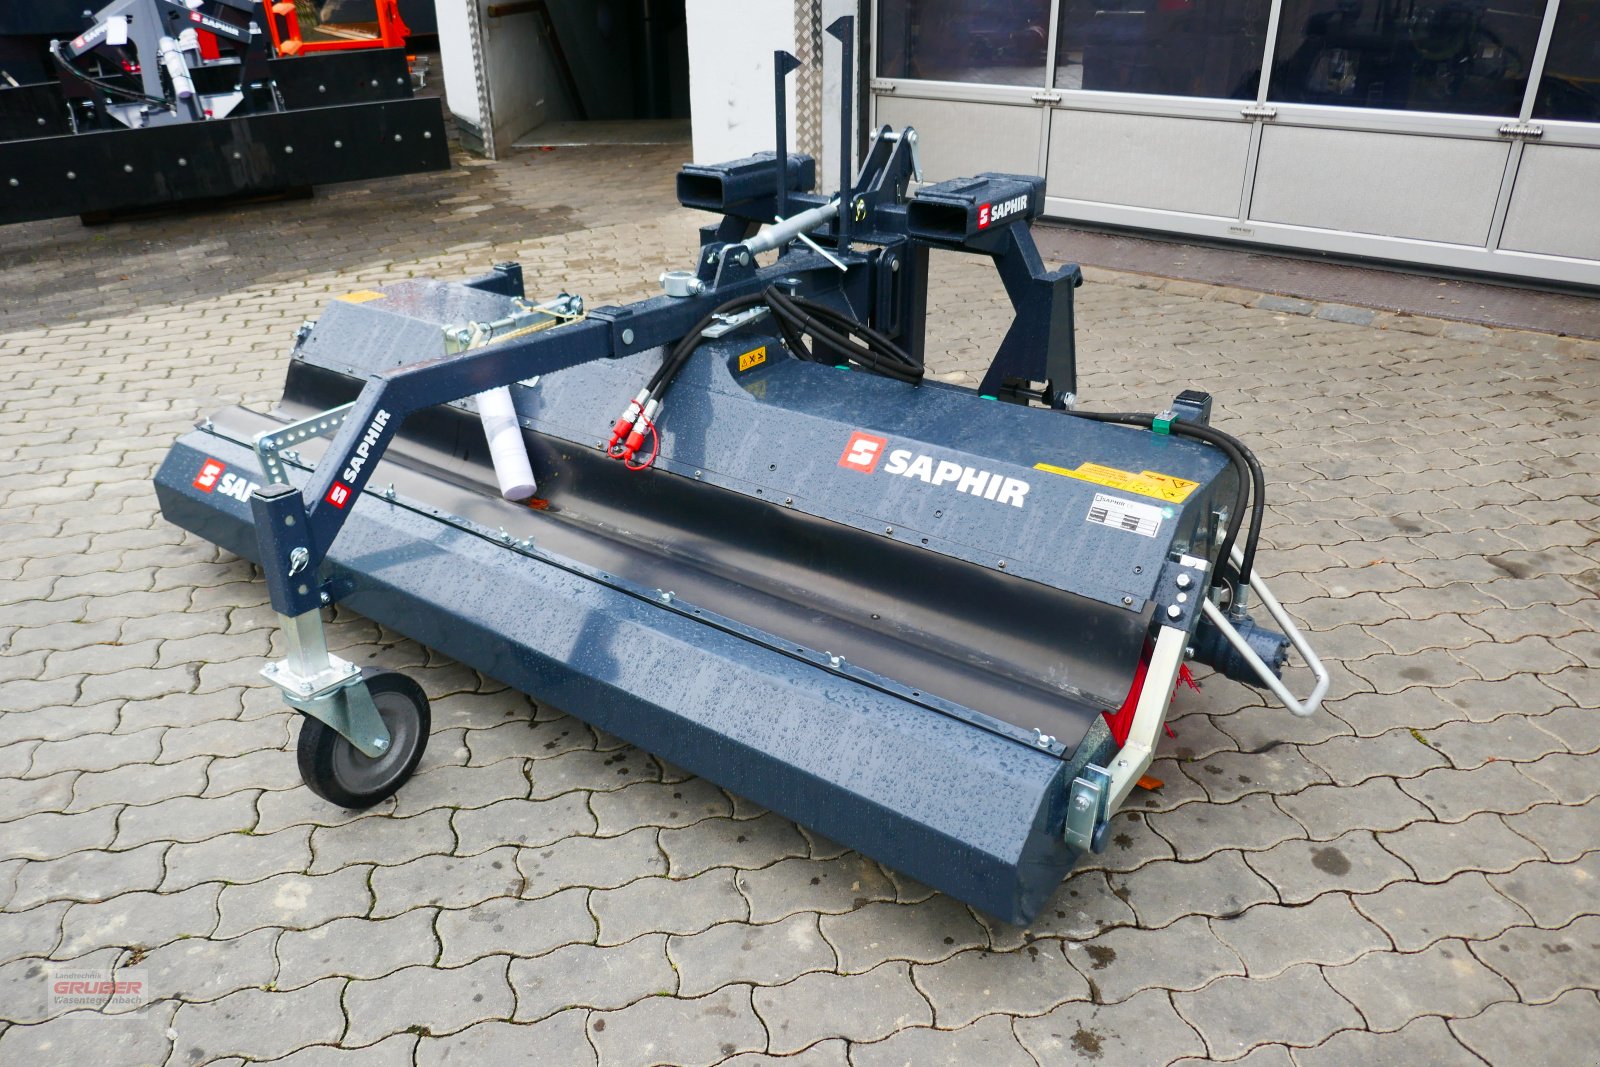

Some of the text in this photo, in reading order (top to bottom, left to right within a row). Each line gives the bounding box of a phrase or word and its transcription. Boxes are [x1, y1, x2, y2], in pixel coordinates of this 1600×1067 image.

[202, 18, 240, 36] SAPHIR
[991, 195, 1028, 222] SAPHIR
[343, 409, 391, 484] SAPHIR
[884, 450, 1030, 508] SAPHIR
